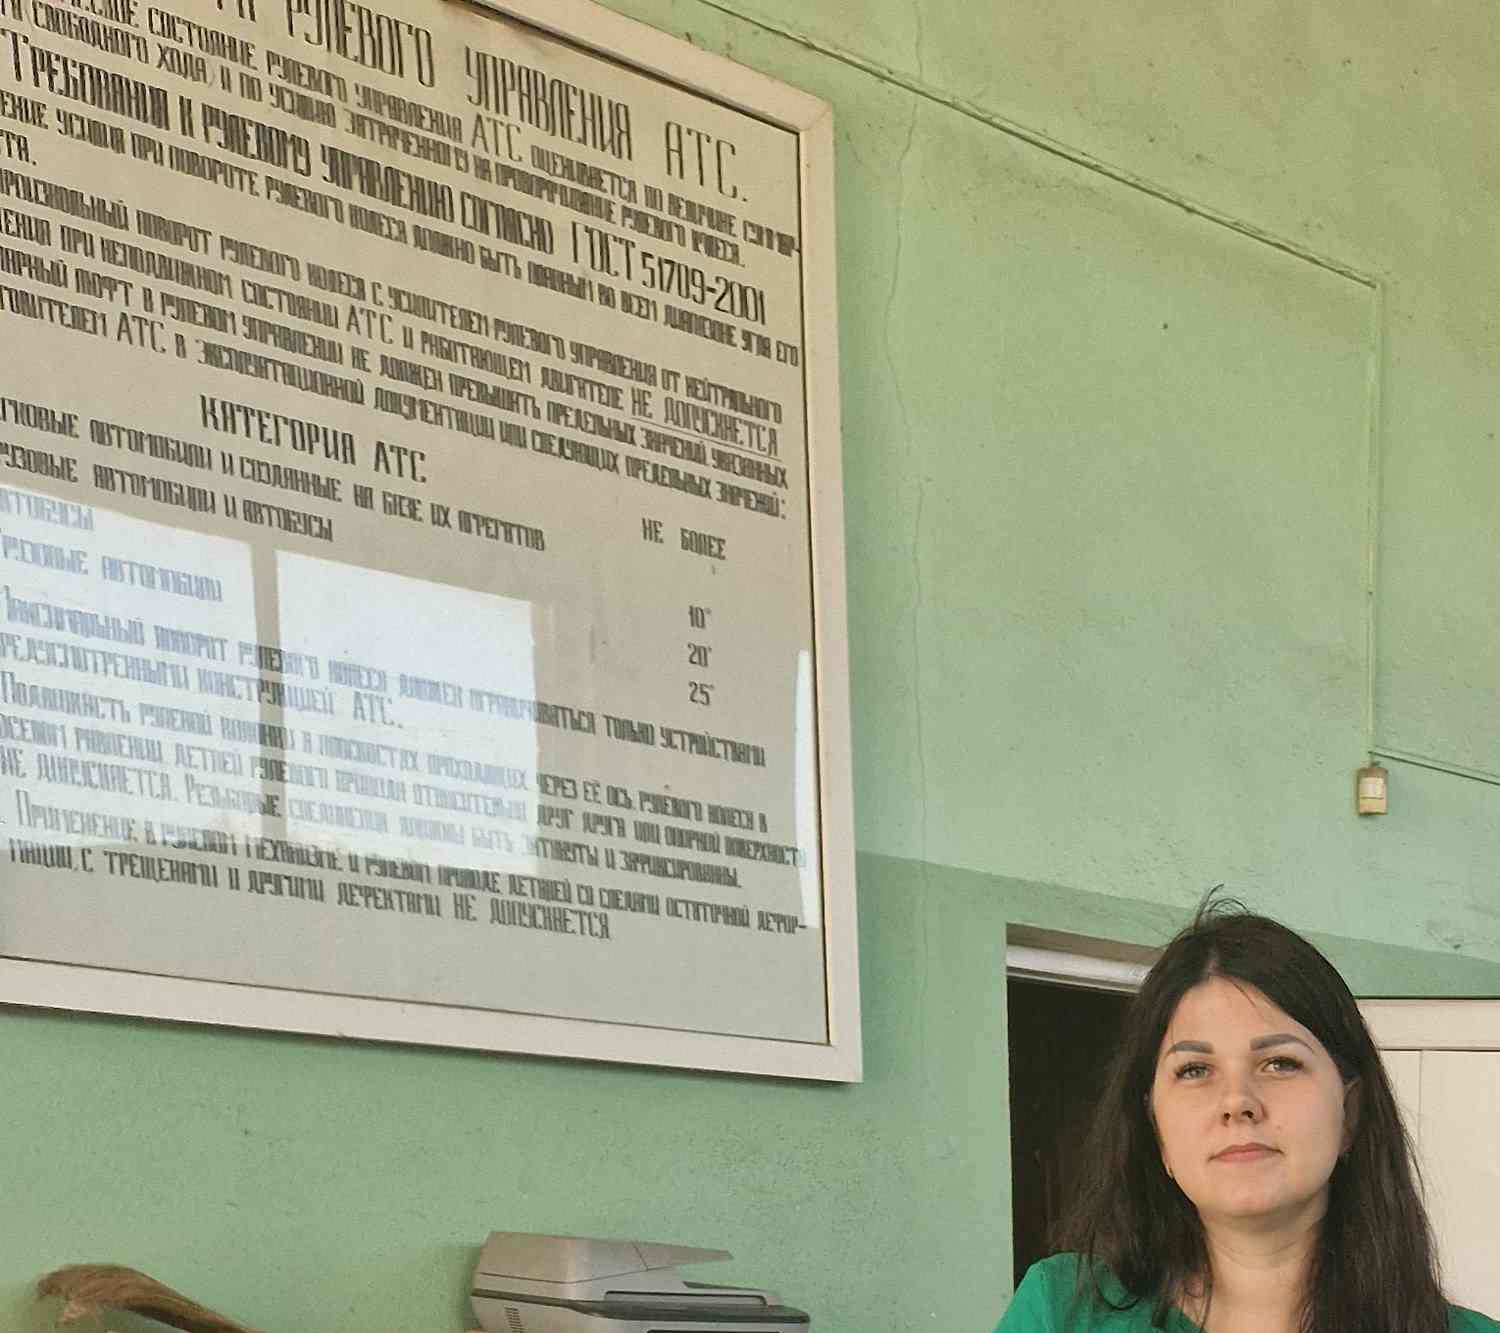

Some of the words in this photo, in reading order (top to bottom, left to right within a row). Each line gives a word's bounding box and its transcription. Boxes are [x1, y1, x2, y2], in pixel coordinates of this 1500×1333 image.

[148, 5, 256, 70] СОСТОЯНИЕ
[266, 49, 347, 102] РУЛЕВОГО
[355, 81, 462, 143] УПРАВЛЕНИЯ
[471, 110, 521, 164] АТС
[644, 184, 662, 212] ПО
[465, 44, 631, 162] УПРАВЛЕНИЯ
[664, 118, 747, 202] АТС.
[220, 64, 231, 92] И
[239, 71, 262, 103] ПО
[473, 153, 491, 182] НА
[621, 205, 685, 248] РУЛЕВОГО
[55, 107, 126, 156] УСИЛИЯ
[132, 132, 164, 167] ПРИ
[170, 144, 259, 197] ПОВОРОТЕ
[266, 175, 344, 224] РУЛЕВОГО
[348, 202, 406, 244] КОЛЕСА
[413, 223, 474, 265] ДОЛЖНО
[479, 245, 521, 280] БЫТЬ
[597, 282, 616, 309] ВО
[620, 290, 656, 322] ВСЕМ
[741, 328, 771, 359] УГЛА
[775, 339, 798, 367] ЕГО
[178, 94, 194, 139] К
[201, 102, 310, 177] РУЛЕВОМУ
[320, 143, 454, 225] УПРАВЛЕНИЮ
[460, 190, 553, 256] СОГЛАСНО
[571, 220, 636, 284] ГОСТ
[641, 249, 765, 326] 51709-2001
[59, 224, 94, 259] ПРИ
[100, 237, 232, 299] НЕПОДВИЖНОМ
[241, 277, 338, 329] СОСТОЯНИИ
[345, 302, 392, 345] АТС
[402, 325, 413, 351] И
[420, 331, 530, 385] РАБОТАЮЩЕМ
[540, 365, 624, 411] ДВИГАТЕЛЕ
[631, 386, 652, 419] НЕ
[663, 396, 777, 457] ДОПУСКАЕТСЯ
[75, 266, 132, 307] ЛЮФТ
[143, 286, 153, 313] В
[160, 292, 236, 336] РУЛЕВОМ
[242, 314, 342, 365] УПРАВЛЕНИИ
[351, 345, 370, 373] НЕ
[379, 353, 442, 394] ДОЛЖЕН
[448, 373, 540, 420] ПРЕВЫШАТЬ
[547, 400, 636, 447] ПРЕДЕЛЬНЫХ
[136, 209, 212, 257] ПОВОРОТ
[220, 235, 300, 282] РУЛЕВОГО
[307, 261, 365, 301] КОЛЕСА
[371, 281, 383, 307] С
[388, 286, 488, 337] УСИЛИТЕЛЕМ
[494, 317, 565, 360] РУЛЕВОГО
[570, 340, 656, 387] УПРАВЛЕНИЯ
[661, 367, 680, 394] ОТ
[684, 371, 782, 424] НЕЙТРАЛЬНОГО
[117, 311, 166, 354] АТС
[175, 333, 187, 359] В
[499, 420, 526, 449] ИЛИ
[625, 454, 711, 499] ПРЕДЕЛЬНЫХ
[200, 394, 355, 466] КАТЕГОРИЯ
[373, 439, 426, 484] АТС
[89, 418, 211, 473] АВТОМОБИЛИ
[221, 451, 233, 477] И
[239, 455, 341, 503] СОЗДАННЫЕ
[352, 483, 373, 510] НА
[382, 490, 422, 522] БАЗЕ
[430, 502, 451, 529] ИХ
[458, 509, 545, 551] АГРЕГАТОВ
[93, 464, 215, 515] АВТОМОБИЛИ
[224, 494, 236, 519] И
[242, 498, 333, 542] АВТОБУСЫ
[642, 517, 664, 545] НЕ
[679, 526, 726, 561] БОЛЕЕ
[687, 641, 712, 669] 20°
[688, 680, 715, 707] 25°
[352, 691, 403, 728] АТС.
[603, 715, 654, 745] ТОЛЬКО
[659, 723, 765, 767] УСТРОЙСТВАМИ
[535, 772, 576, 800] ЧЕРЕЗ
[639, 791, 702, 822] РУЛЕВОГО
[707, 804, 753, 831] КОЛЕСА
[759, 813, 767, 833] В
[536, 803, 573, 830] ДРУГ
[582, 811, 625, 839] ДРУГА
[633, 820, 659, 844] ИЛИ
[81, 848, 94, 873] С
[103, 851, 217, 890] ТРЕЩЕНАМИ
[229, 868, 240, 892] И
[247, 870, 323, 903] ДРУГИМИ
[337, 882, 440, 918] ДЕФЕКТАМИ
[453, 893, 477, 922] НЕ
[489, 898, 608, 940] ДОПУСКАЕТСЯ
[348, 852, 358, 873] И
[365, 855, 431, 884] РУЛЕВОМ
[576, 884, 593, 906] СО
[599, 887, 659, 915] СЛЕДАМИ
[605, 847, 614, 869] И
